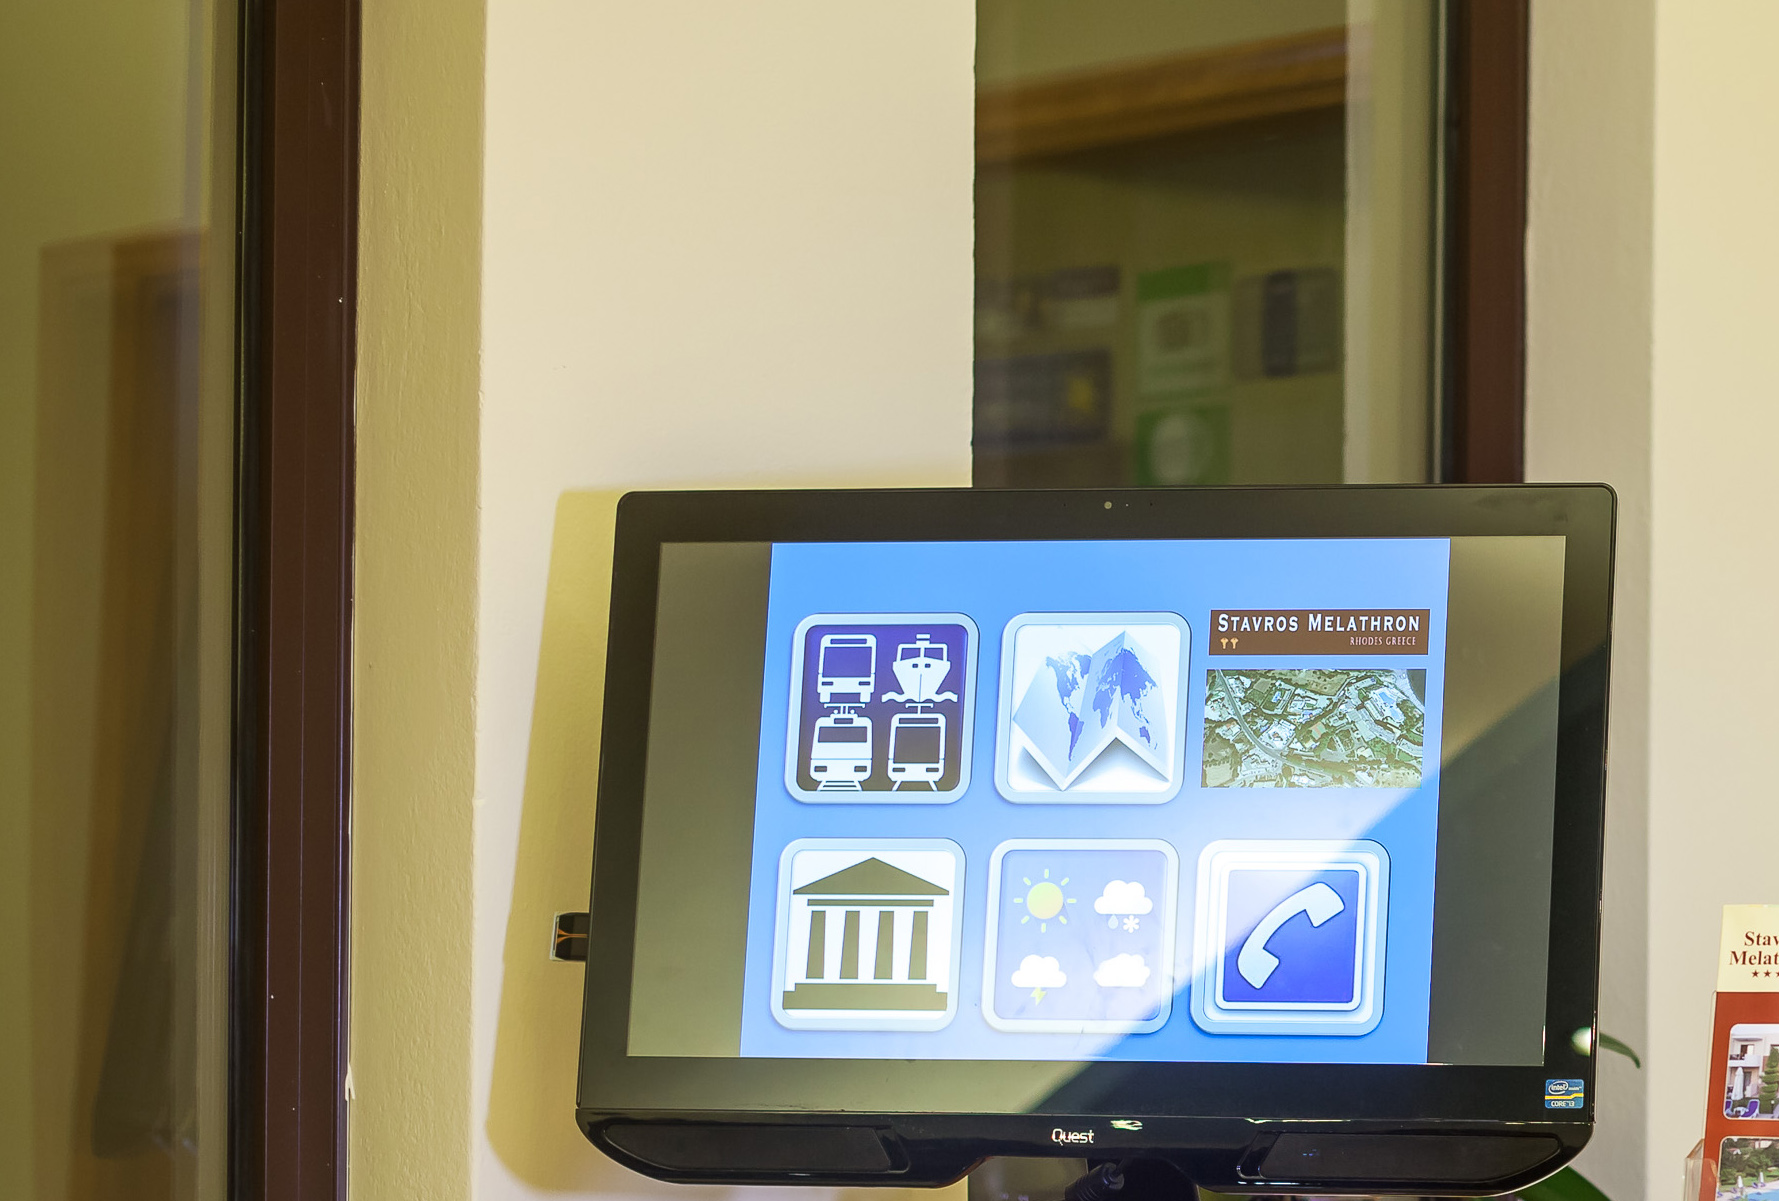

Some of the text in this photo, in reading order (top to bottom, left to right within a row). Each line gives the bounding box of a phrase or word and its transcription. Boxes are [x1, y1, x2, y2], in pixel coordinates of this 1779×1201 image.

[1217, 613, 1420, 632] STAVROS MELATHRON
[1350, 636, 1416, 646] RHODES GREECE
[1052, 1128, 1094, 1146] Quest
